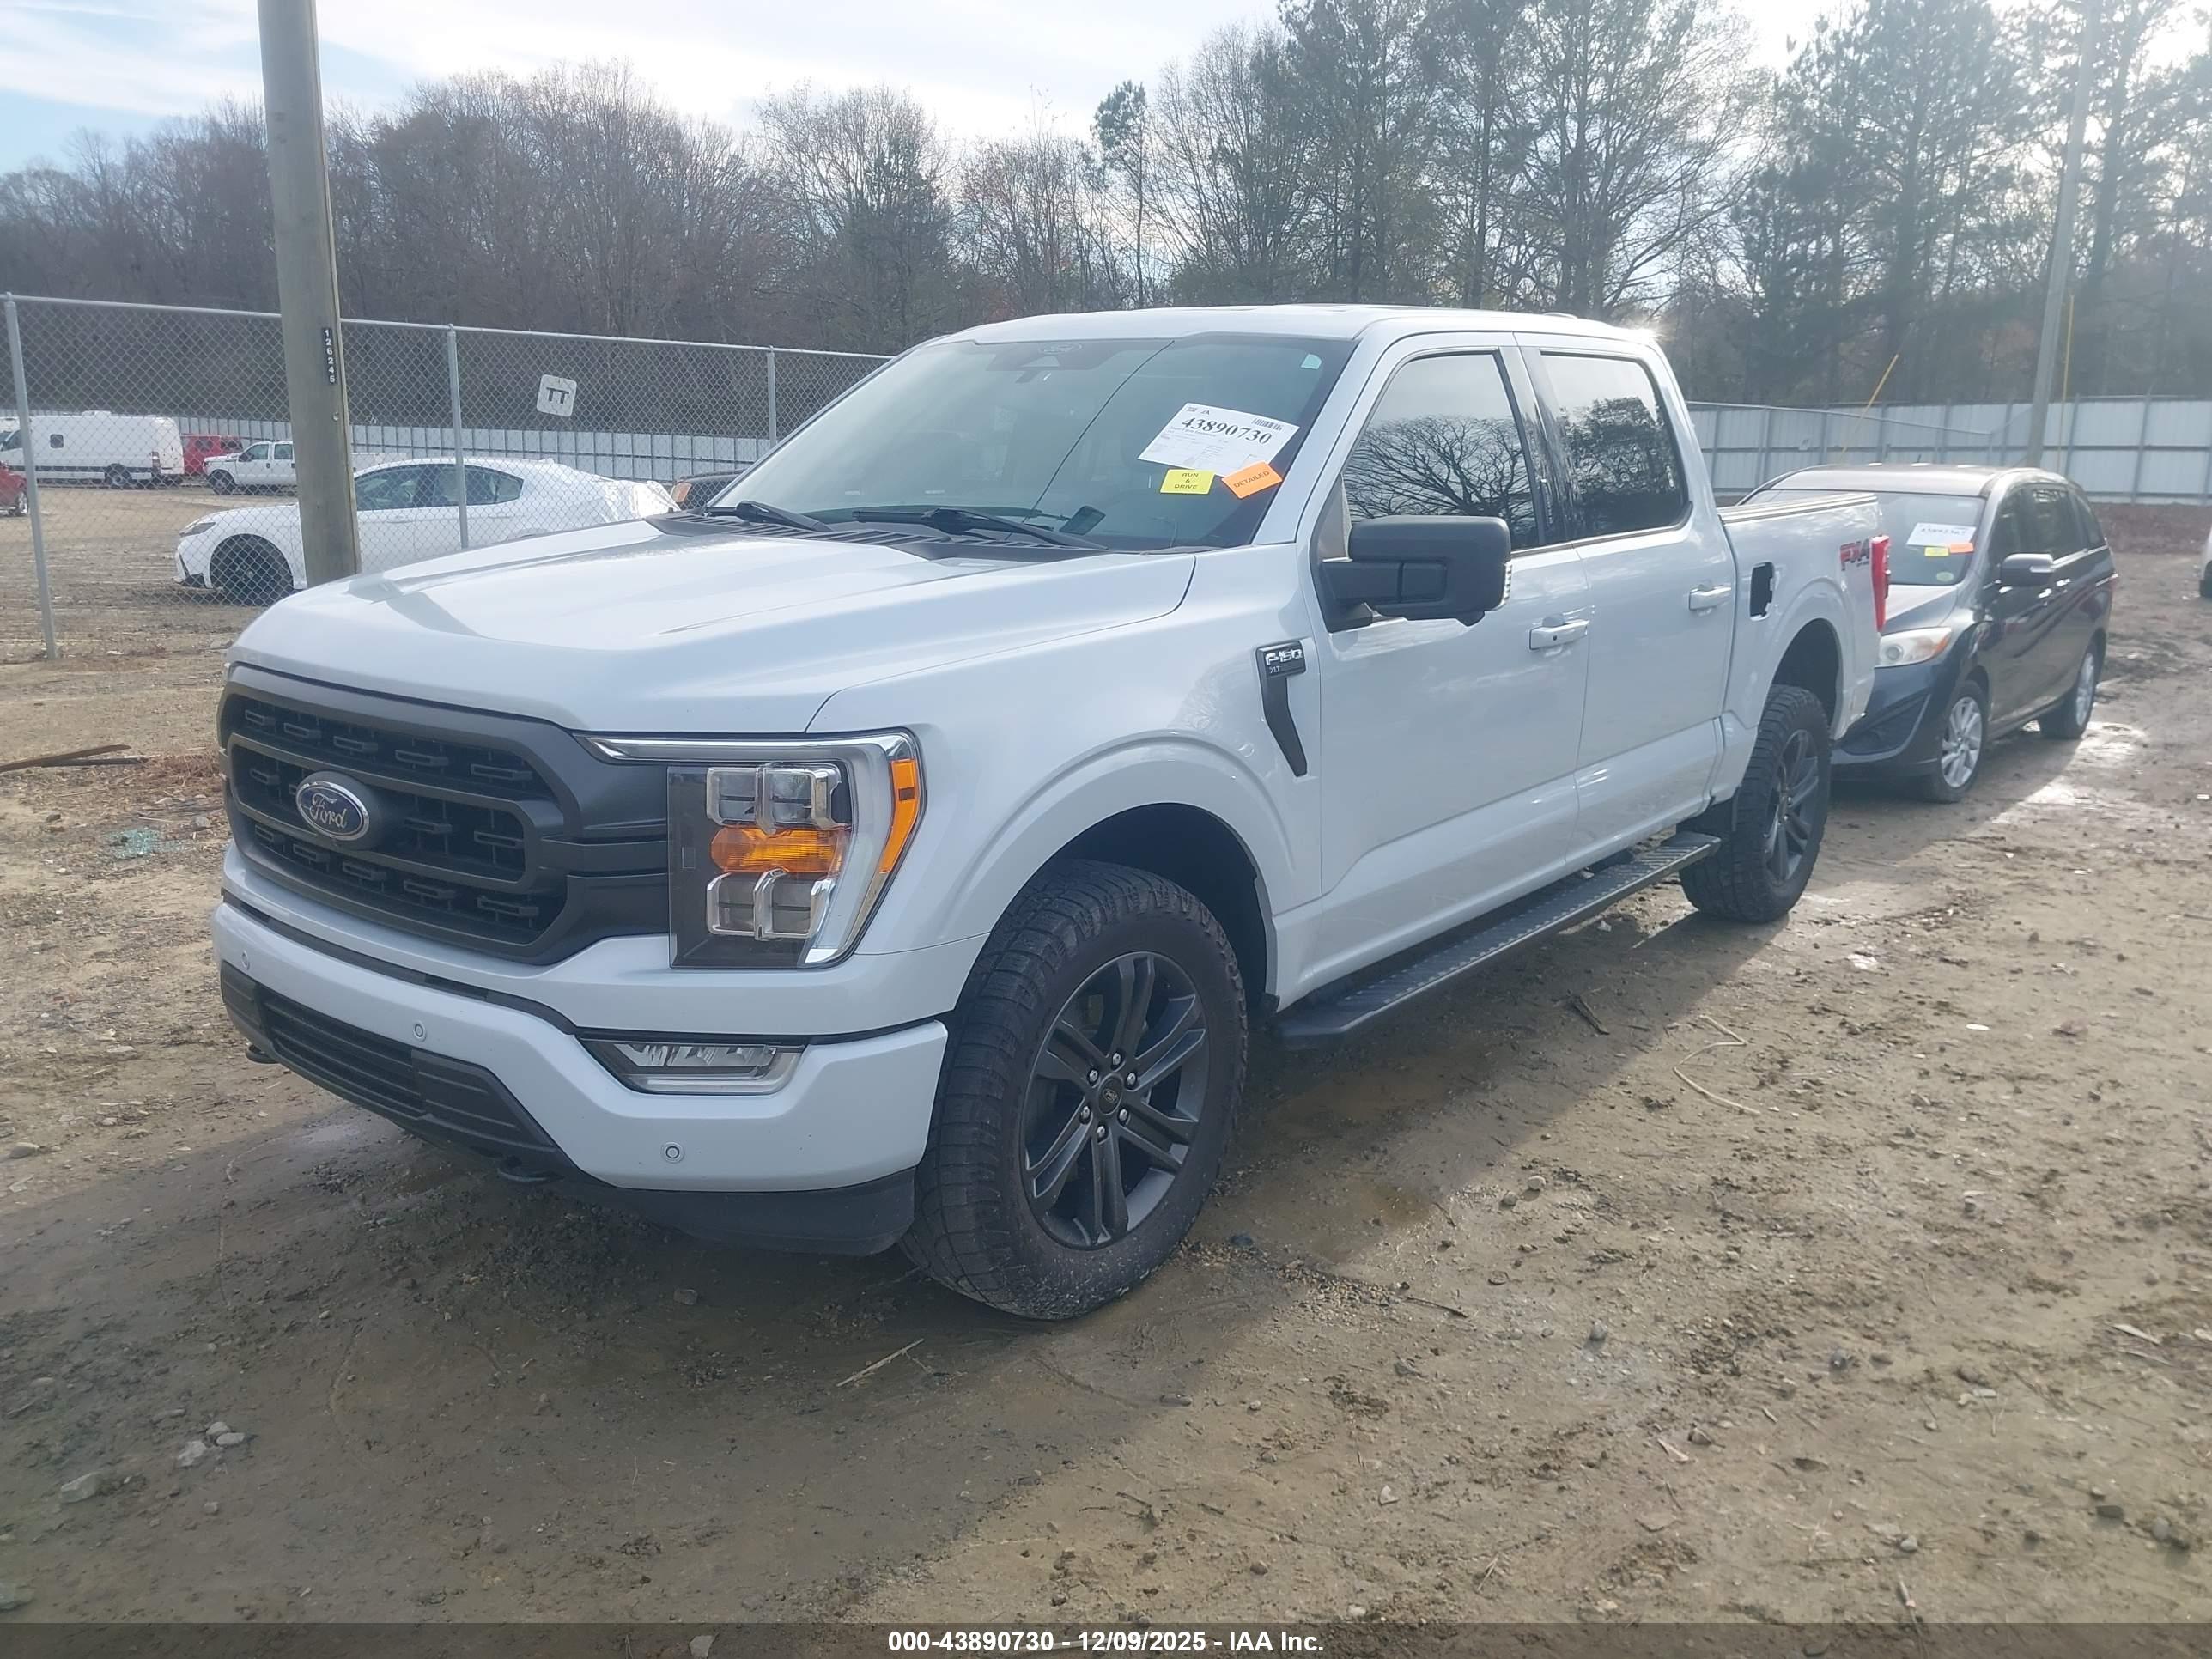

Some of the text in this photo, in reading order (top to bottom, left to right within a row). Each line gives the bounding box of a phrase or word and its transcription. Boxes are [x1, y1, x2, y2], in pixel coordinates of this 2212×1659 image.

[324, 329, 336, 383] 126245
[545, 386, 570, 404] TT
[1182, 417, 1273, 444] 43890730
[1233, 471, 1270, 488] DETAILED
[1265, 649, 1303, 665] F-150
[309, 793, 348, 829] Ford
